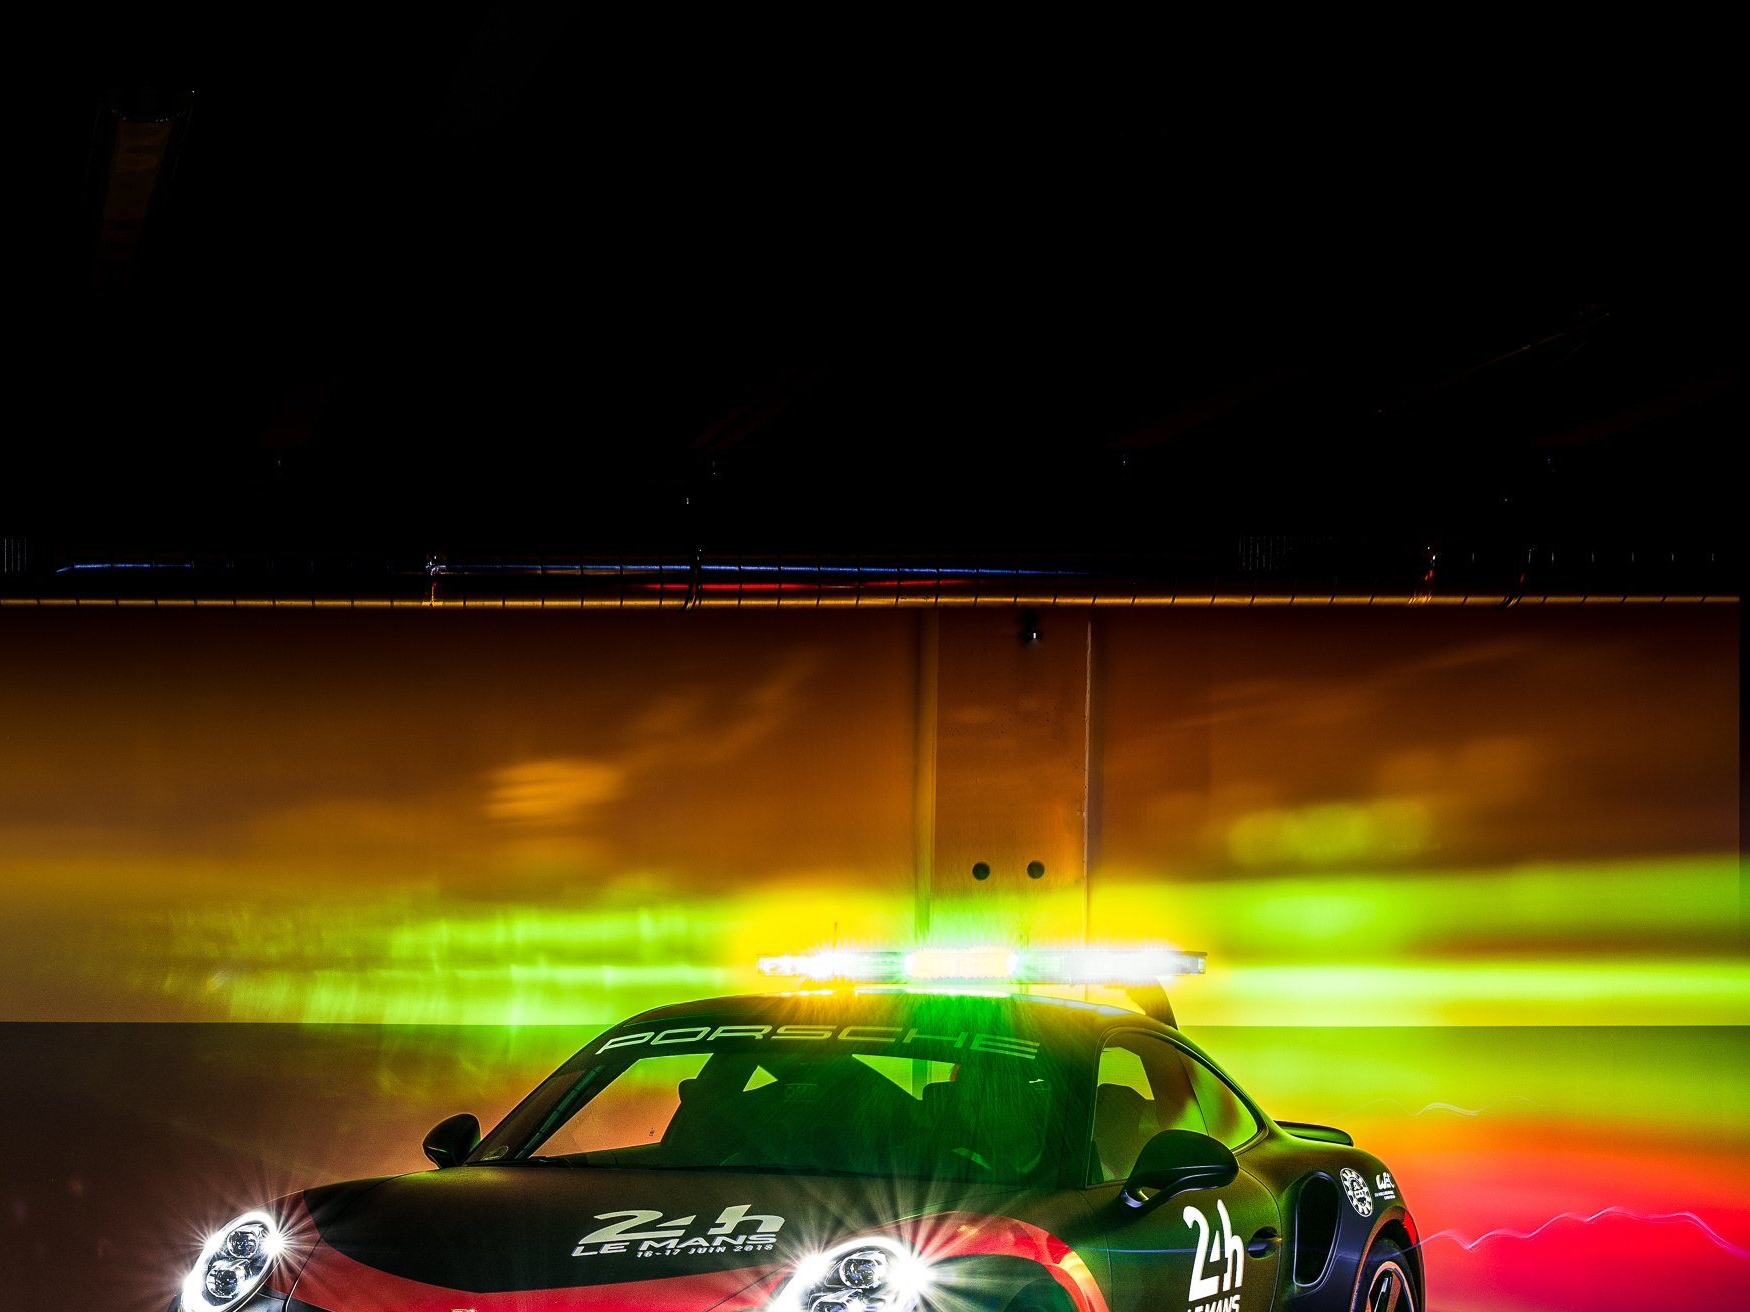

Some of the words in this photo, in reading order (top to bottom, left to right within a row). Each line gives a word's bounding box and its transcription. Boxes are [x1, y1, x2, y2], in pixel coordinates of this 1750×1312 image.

[595, 1024, 1041, 1060] PORSCHE
[578, 1204, 785, 1245] 24h
[571, 1242, 630, 1257] LE
[637, 1233, 778, 1251] MANS
[636, 1249, 681, 1258] 16-17
[687, 1246, 726, 1255] JUIN
[732, 1243, 775, 1253] 2018
[1183, 1199, 1245, 1301] 24h
